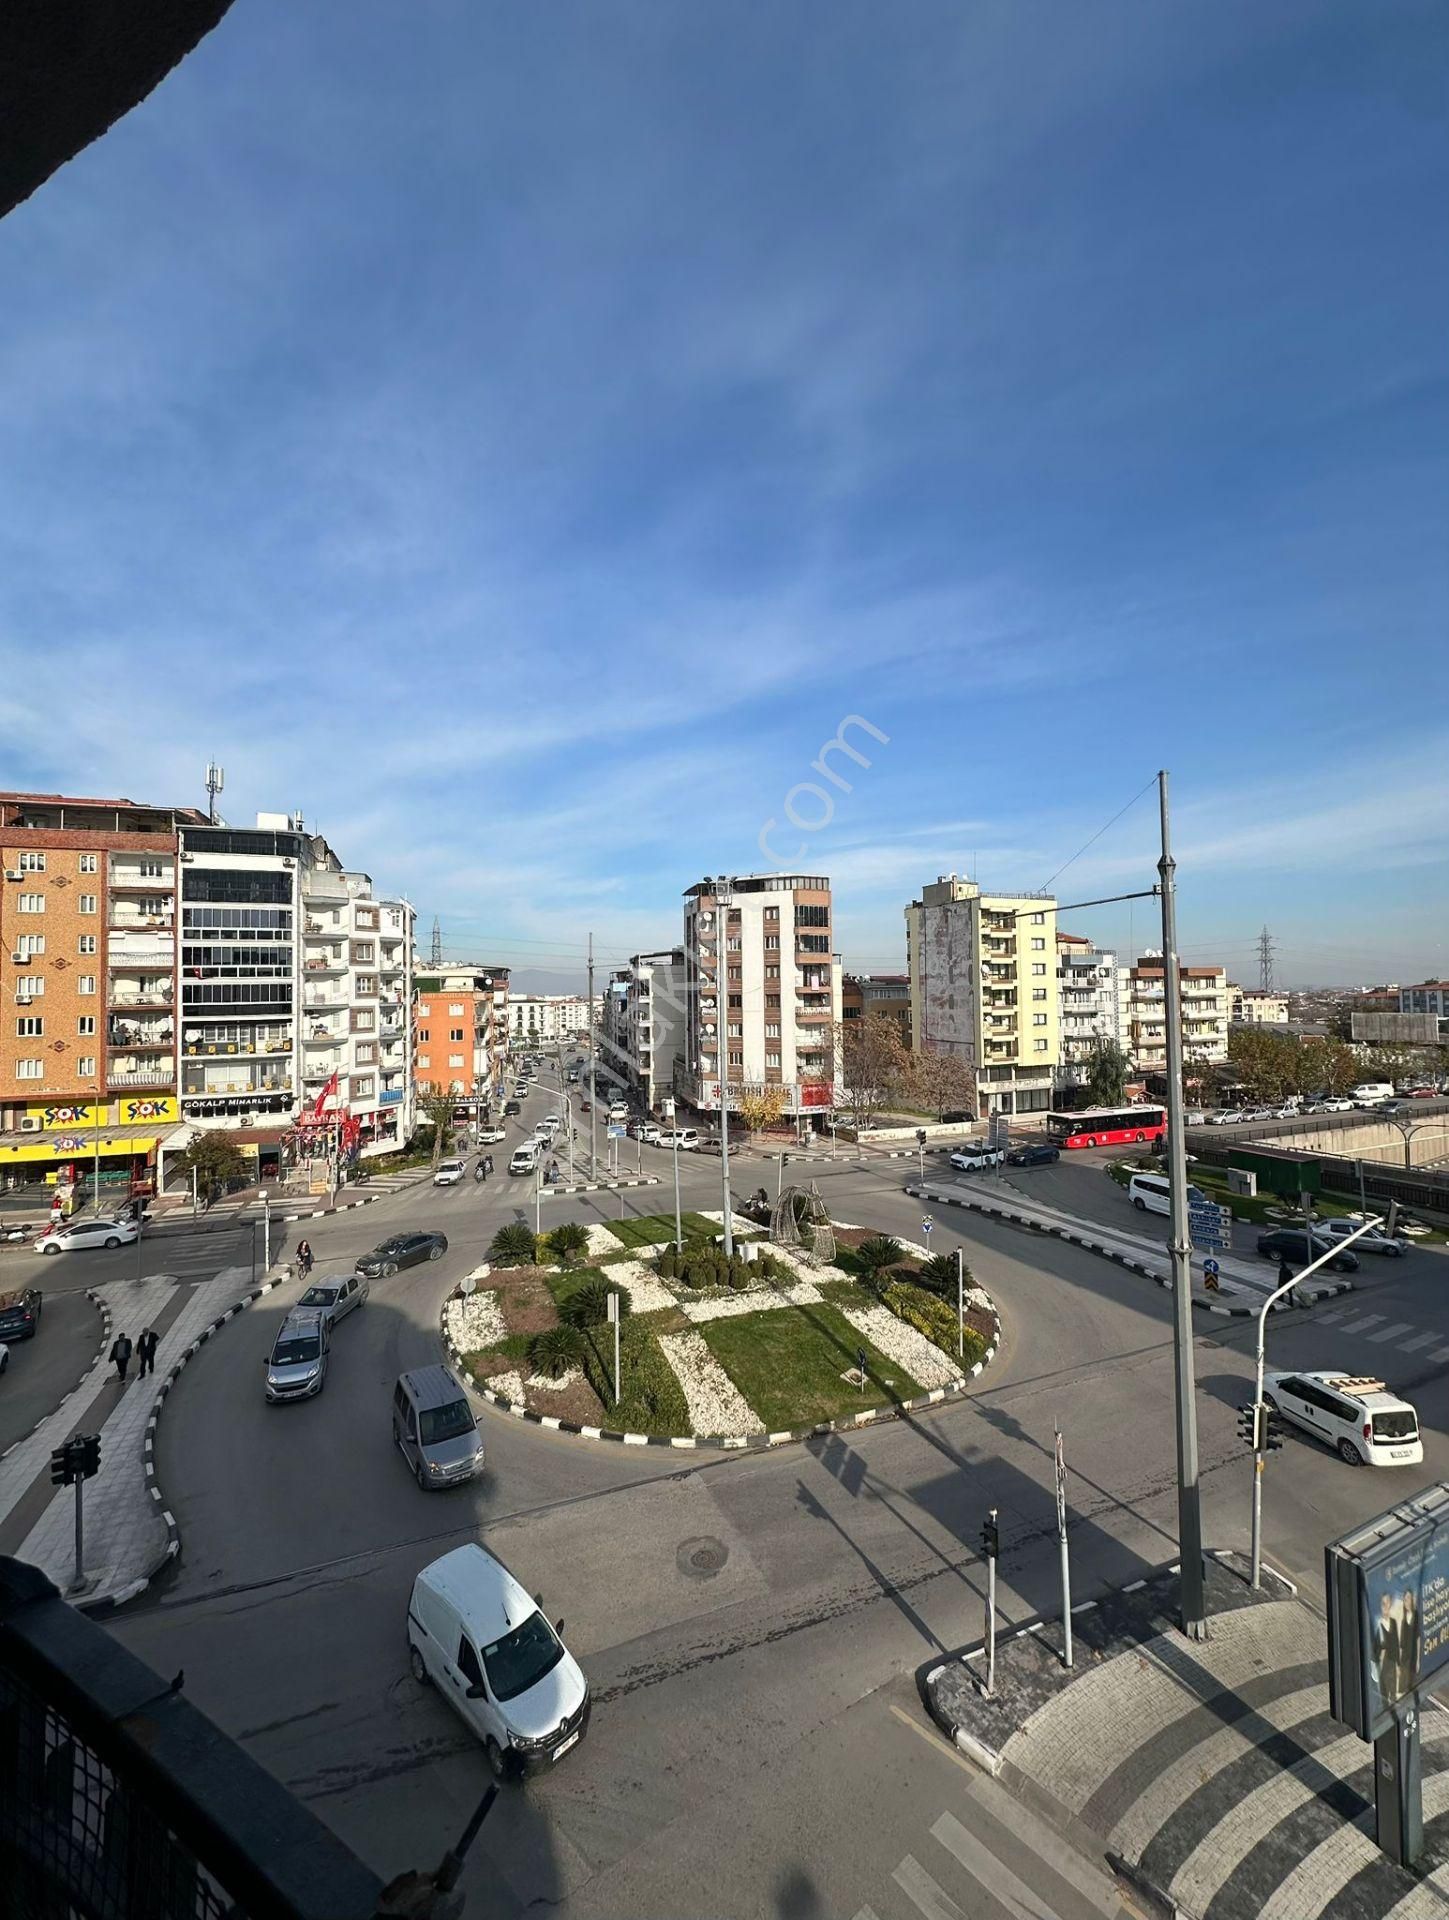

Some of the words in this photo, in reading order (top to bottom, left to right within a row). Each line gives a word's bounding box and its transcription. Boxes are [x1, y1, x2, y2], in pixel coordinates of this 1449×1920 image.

[127, 1100, 170, 1121] ŞOK
[184, 1100, 226, 1109] GÖKALP
[44, 1105, 90, 1126] ŞOK
[304, 1114, 342, 1124] BAYRAK
[53, 1136, 87, 1155] ŞOK
